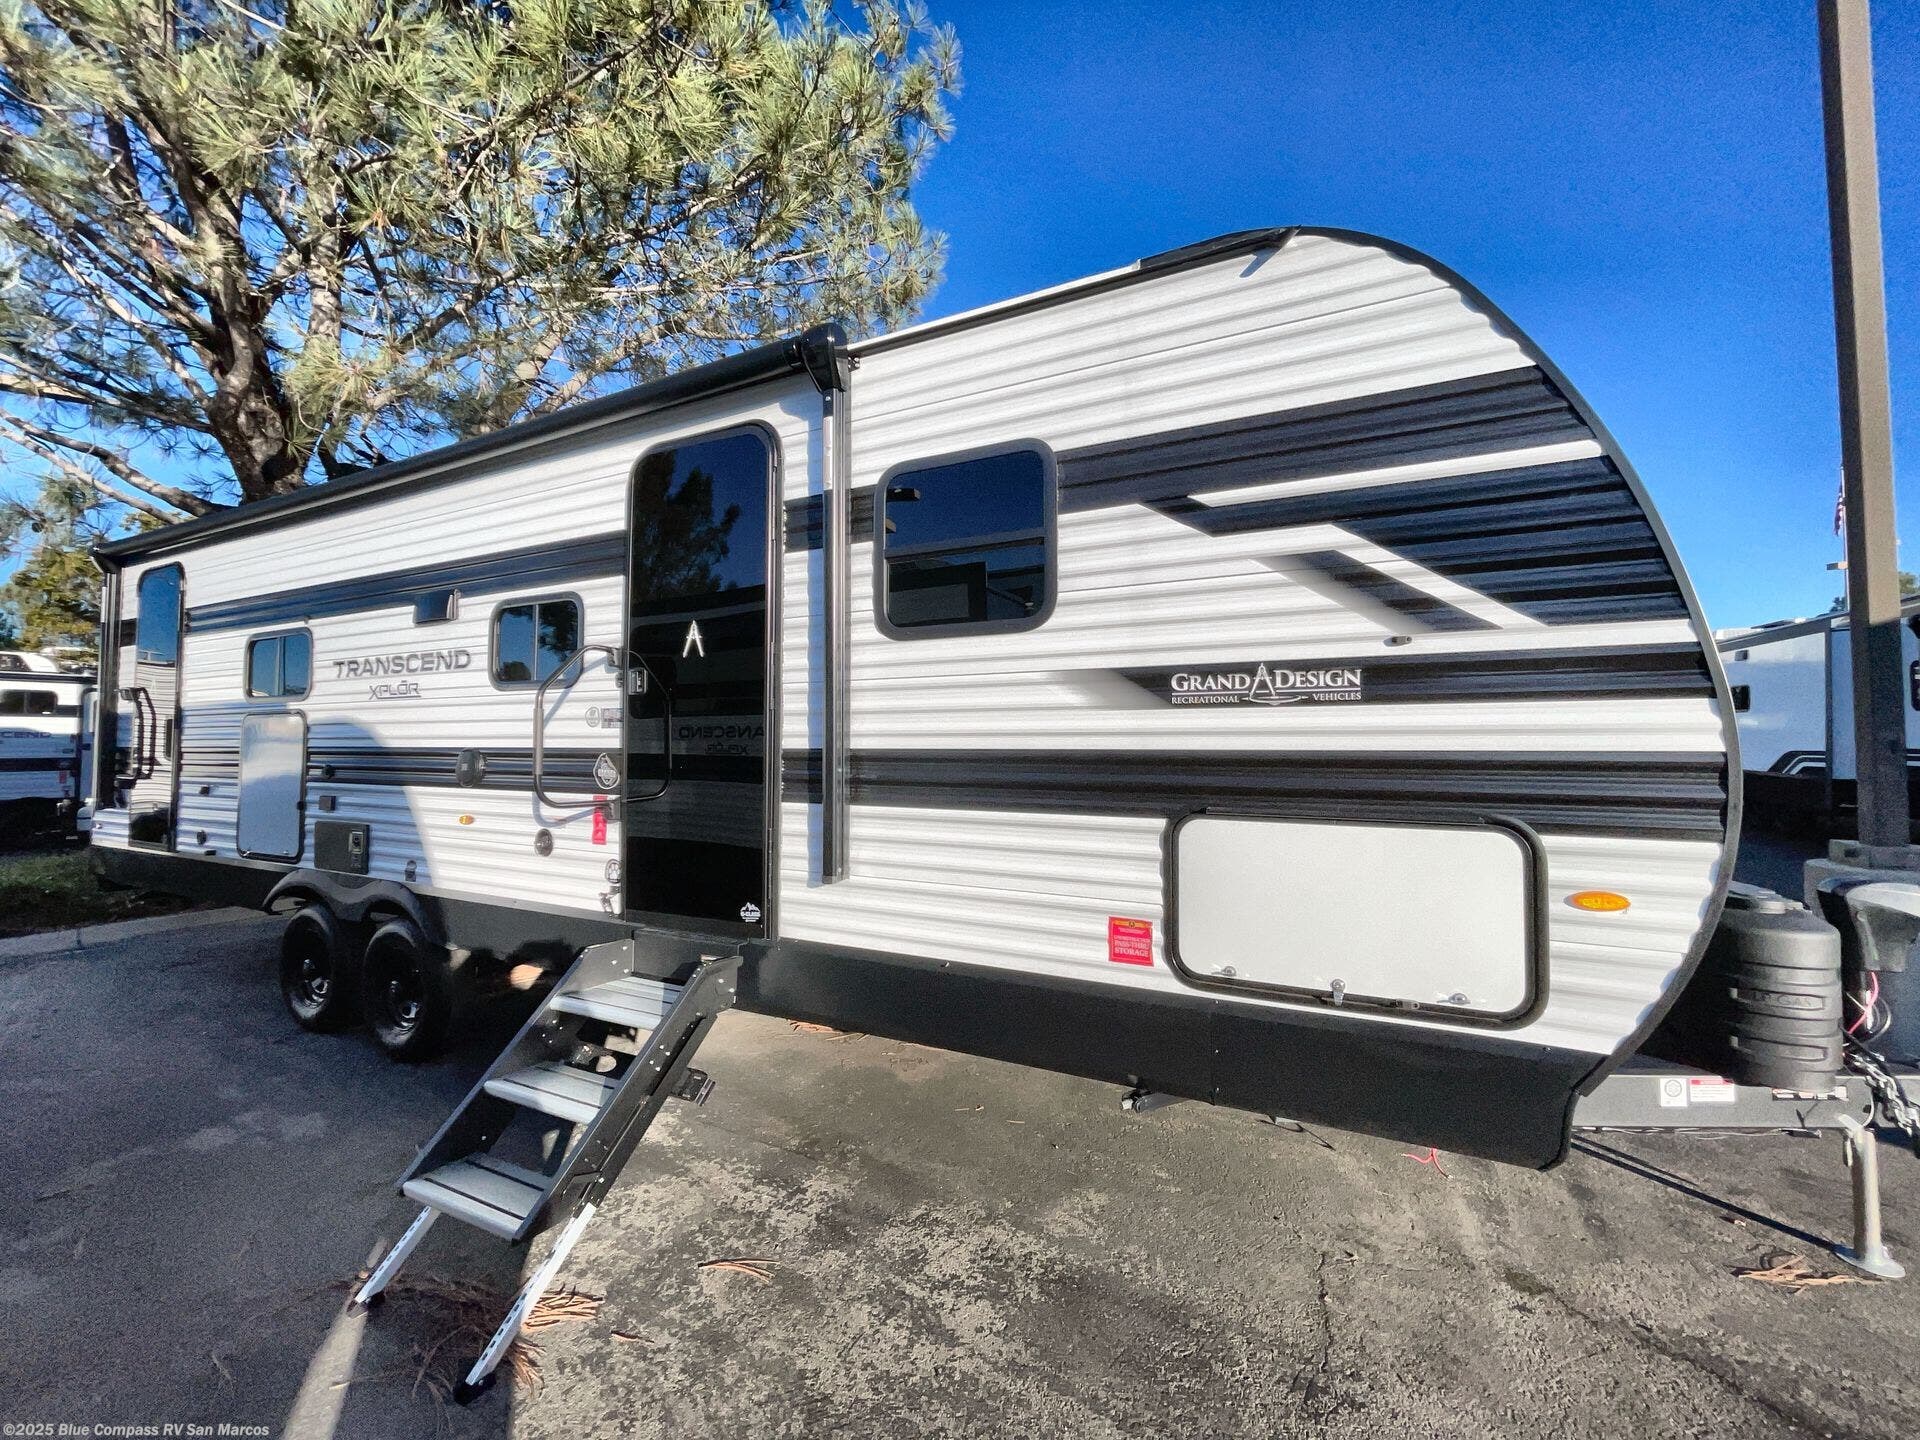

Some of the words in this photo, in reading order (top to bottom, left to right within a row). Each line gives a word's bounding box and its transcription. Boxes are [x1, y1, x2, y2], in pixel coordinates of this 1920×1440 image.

[333, 649, 471, 678] TRANSCEND
[1170, 673, 1250, 692] GRAND
[1273, 669, 1362, 688] DESIGN
[1171, 695, 1240, 705] RECREATIONAL
[1312, 691, 1362, 701] VEHICLES
[1114, 947, 1150, 958] STORAGE
